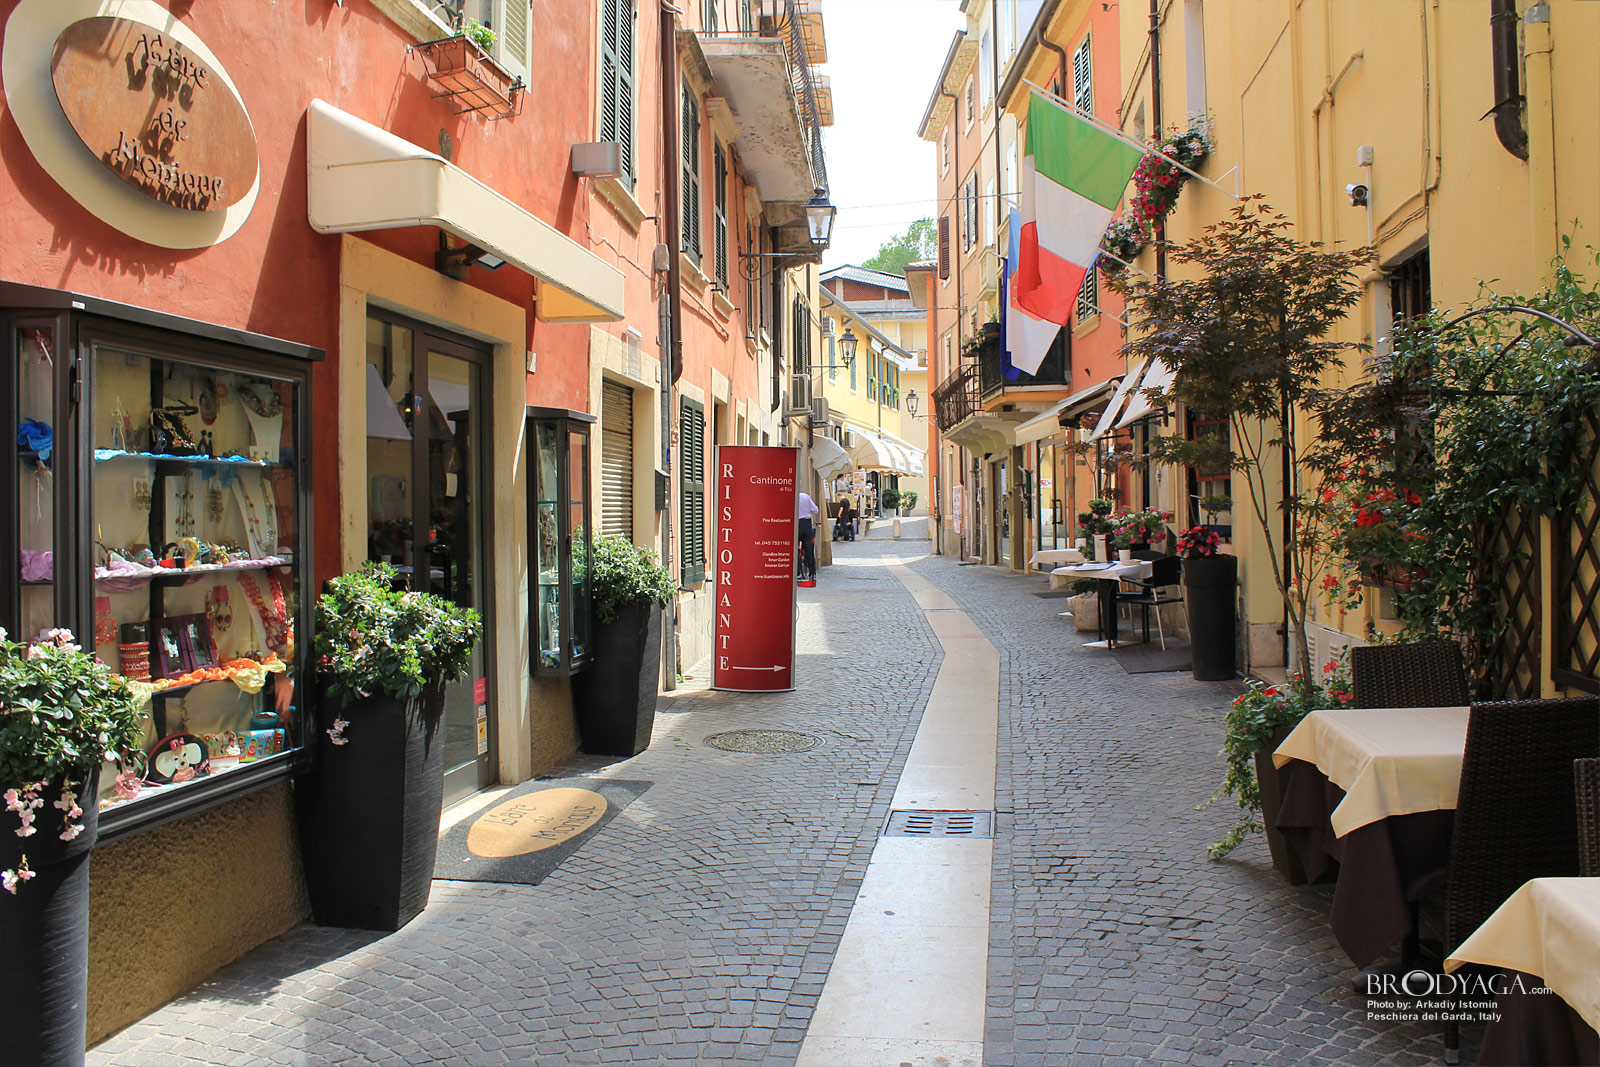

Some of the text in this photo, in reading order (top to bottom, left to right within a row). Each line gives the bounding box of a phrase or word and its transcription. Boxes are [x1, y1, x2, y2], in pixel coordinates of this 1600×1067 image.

[159, 107, 189, 142] de
[116, 130, 226, 202] Monique
[749, 475, 793, 485] Cantinone
[719, 463, 734, 671] RISTORANTE
[530, 805, 599, 841] Monique
